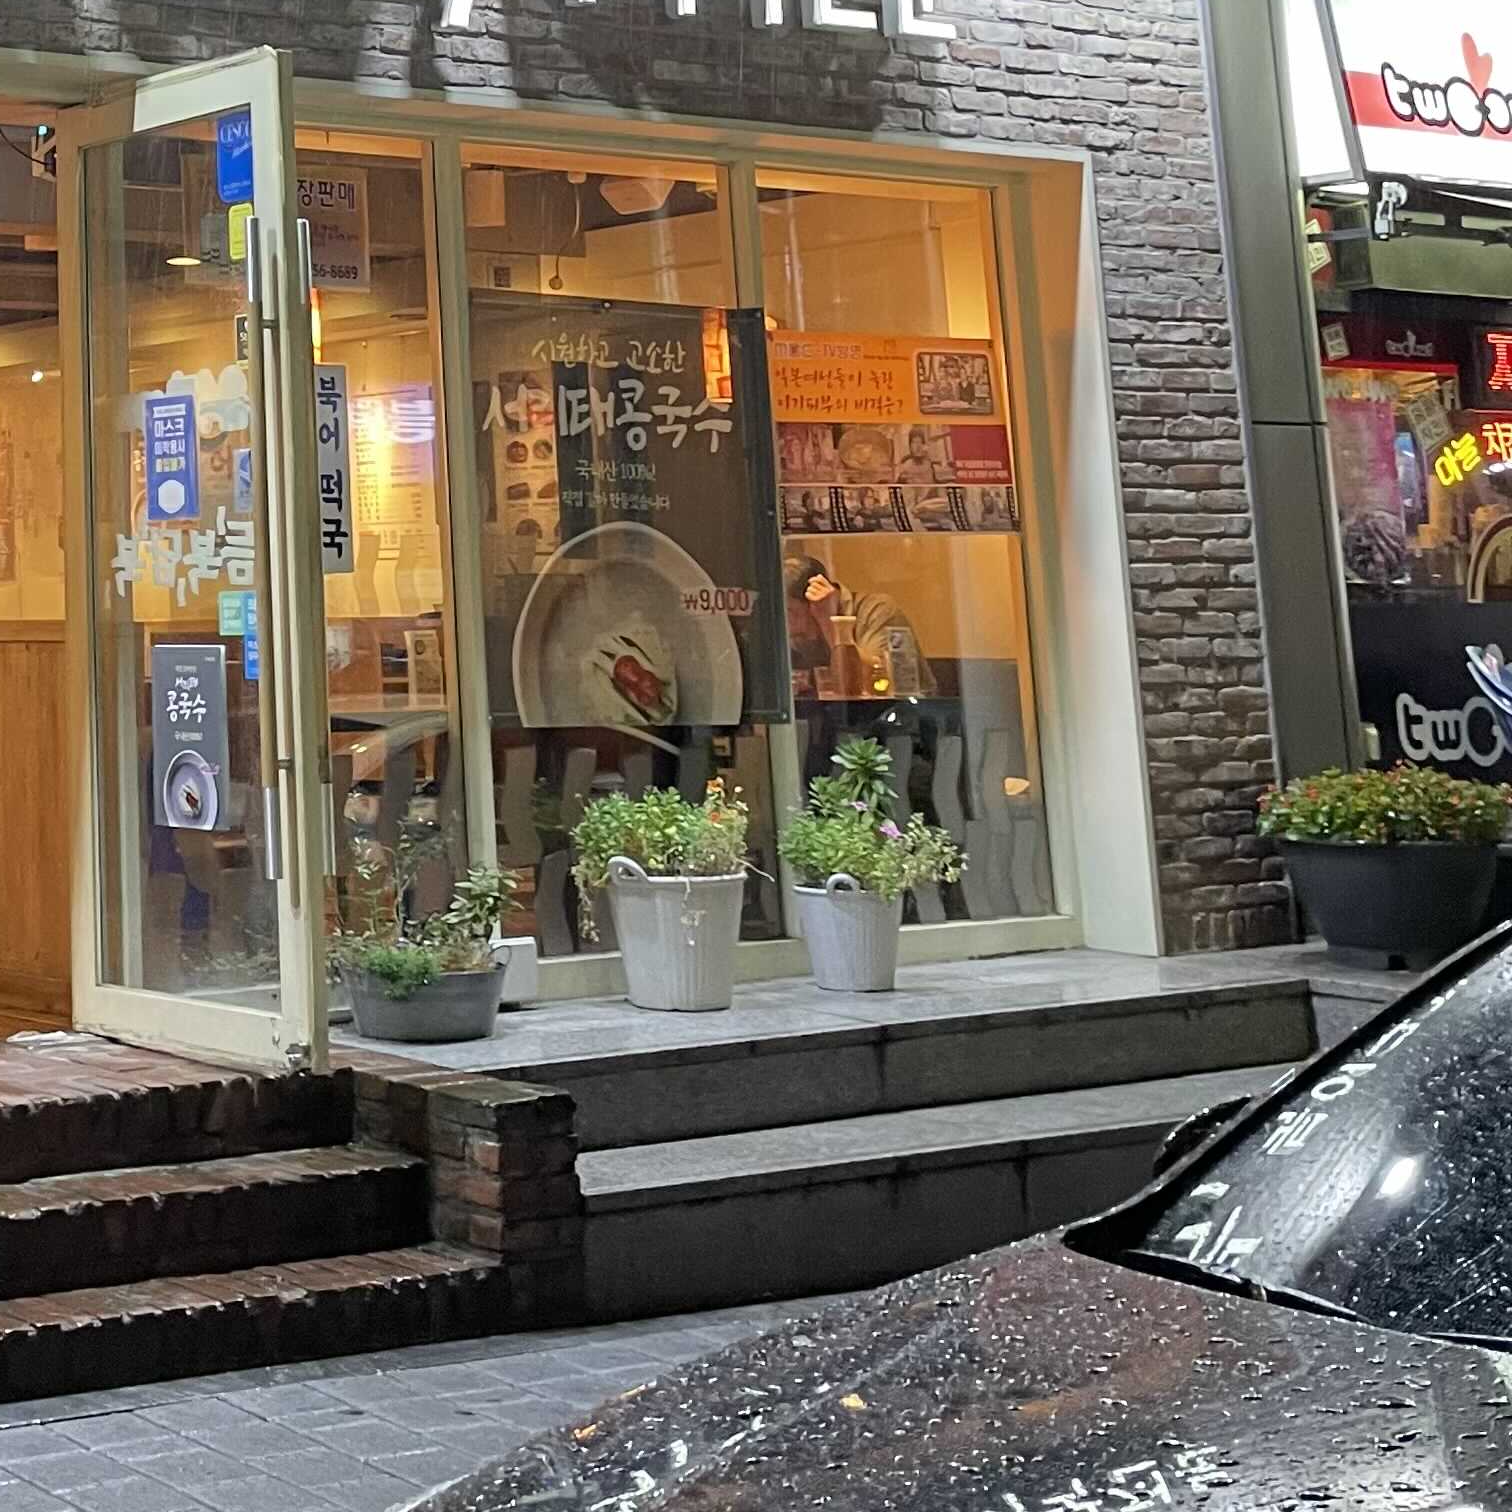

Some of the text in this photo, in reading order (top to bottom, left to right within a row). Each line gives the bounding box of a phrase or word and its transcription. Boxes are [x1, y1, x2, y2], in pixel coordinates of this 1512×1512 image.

[626, 340, 687, 374] 고소한
[154, 418, 185, 438] 마스크
[166, 691, 207, 723] 콩국수
